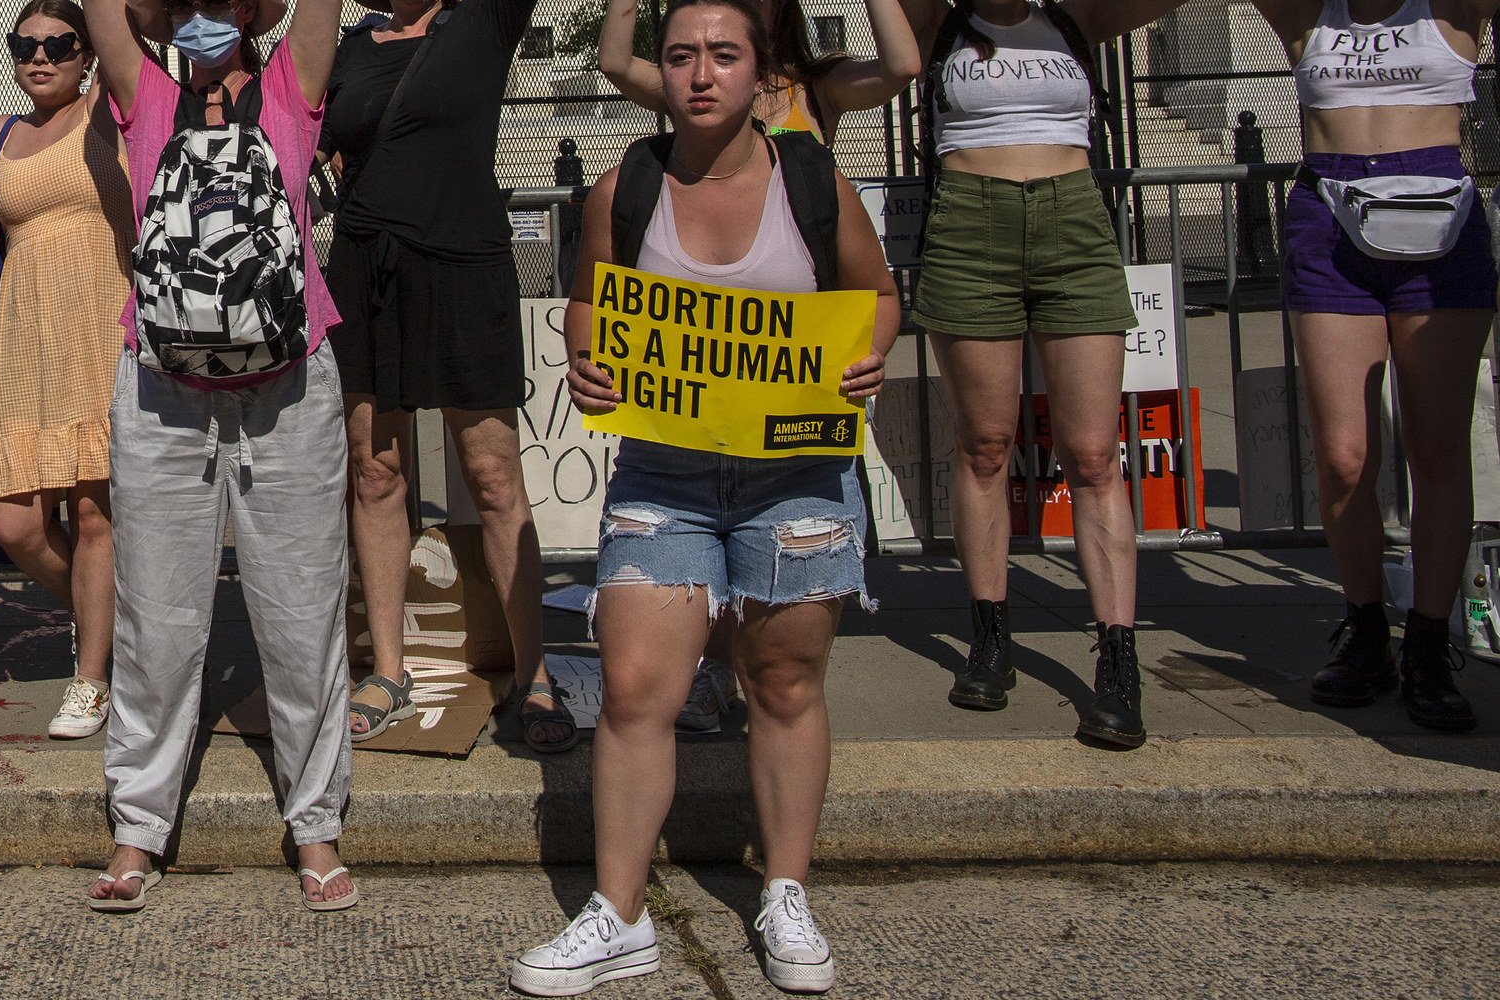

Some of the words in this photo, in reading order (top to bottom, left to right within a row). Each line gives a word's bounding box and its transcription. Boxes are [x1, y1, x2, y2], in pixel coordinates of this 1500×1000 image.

[1331, 28, 1410, 53] FUCK
[1339, 52, 1385, 67] THE
[1308, 65, 1424, 82] PATRIARCHY
[879, 198, 920, 217] ARE
[597, 271, 794, 339] ABORTION
[1131, 291, 1163, 312] THE
[597, 315, 631, 360] IS
[643, 328, 666, 368] A
[680, 333, 822, 385] HUMAN
[774, 421, 824, 435] AMNESTY
[773, 433, 822, 443] INTERNATIONAL
